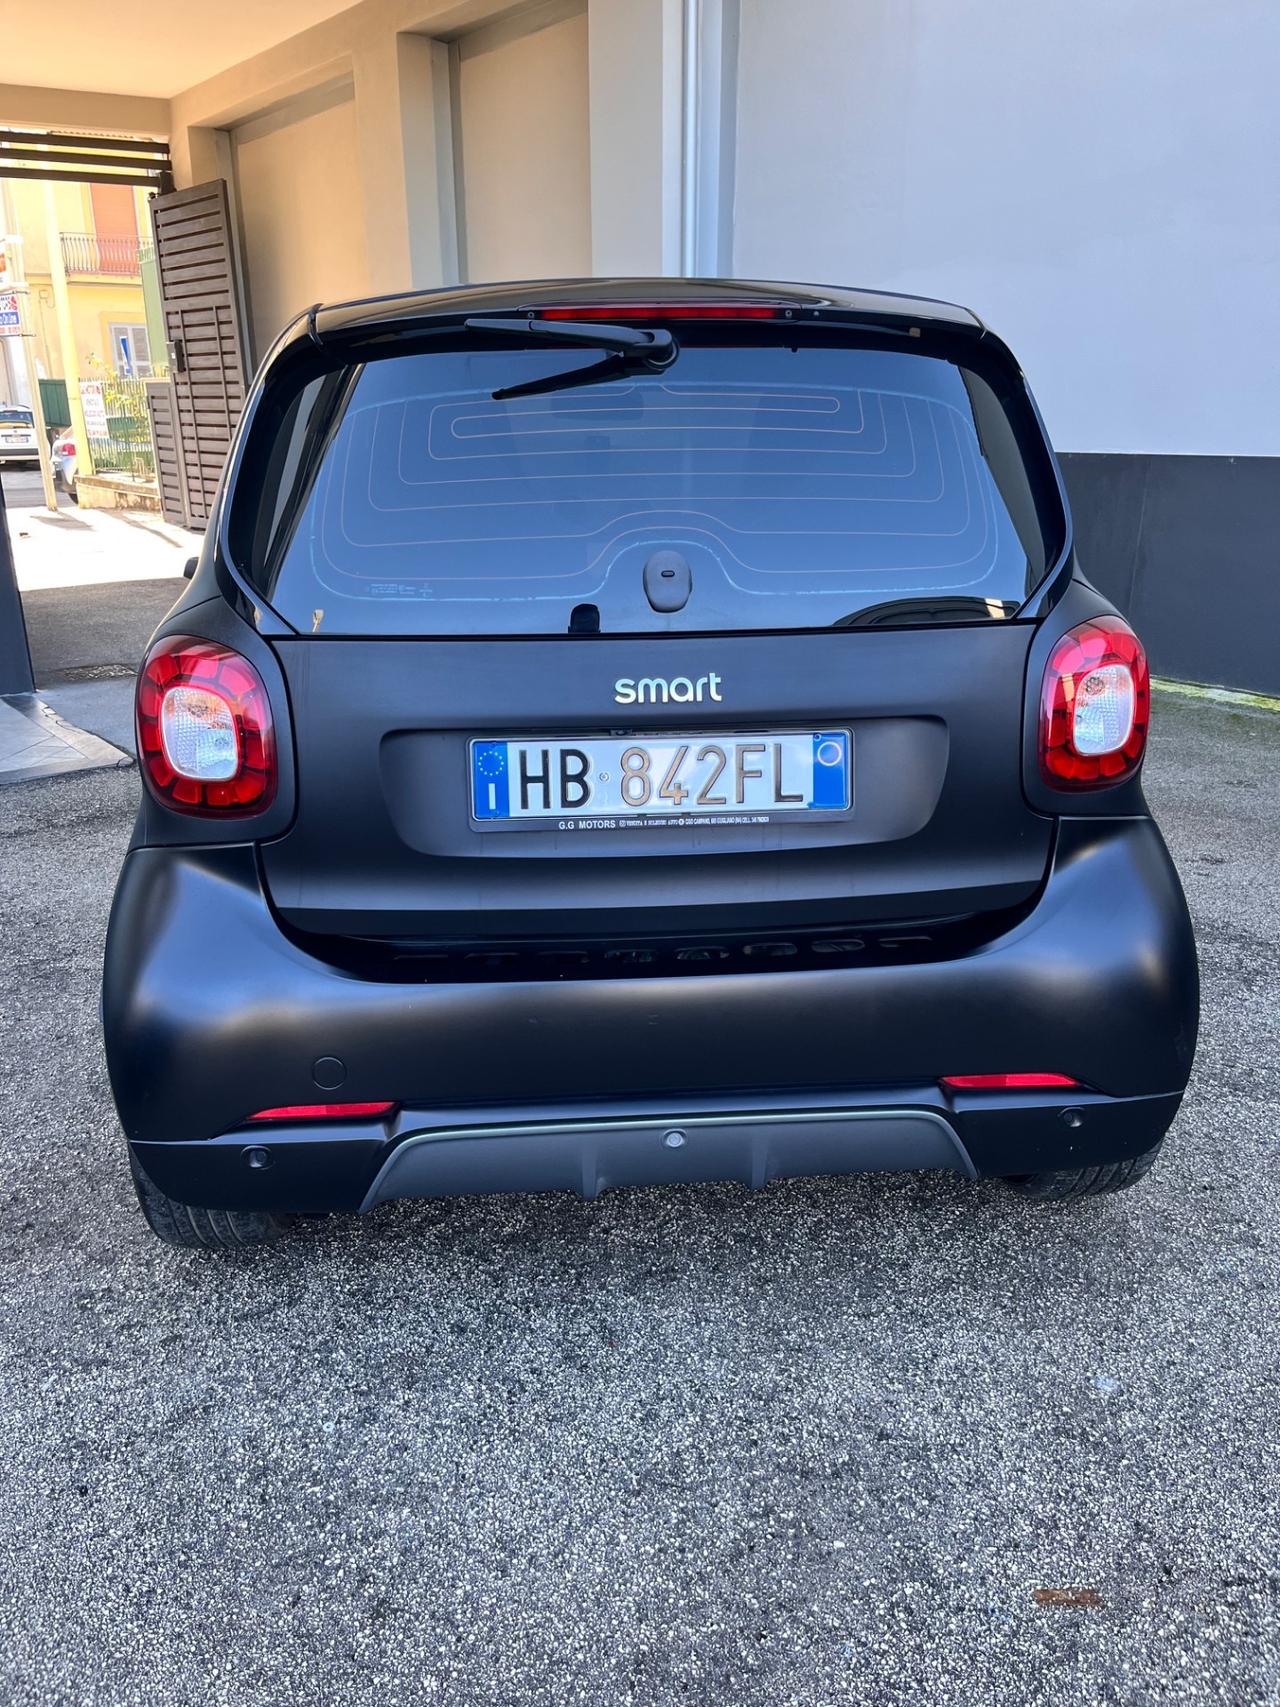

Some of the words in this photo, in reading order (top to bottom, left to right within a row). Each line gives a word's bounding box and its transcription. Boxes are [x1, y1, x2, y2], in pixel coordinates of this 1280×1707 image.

[614, 672, 723, 704] smart
[518, 748, 592, 810] HB
[620, 743, 804, 807] 842FL
[558, 821, 575, 830] G.G
[578, 820, 616, 829] MOTORS
